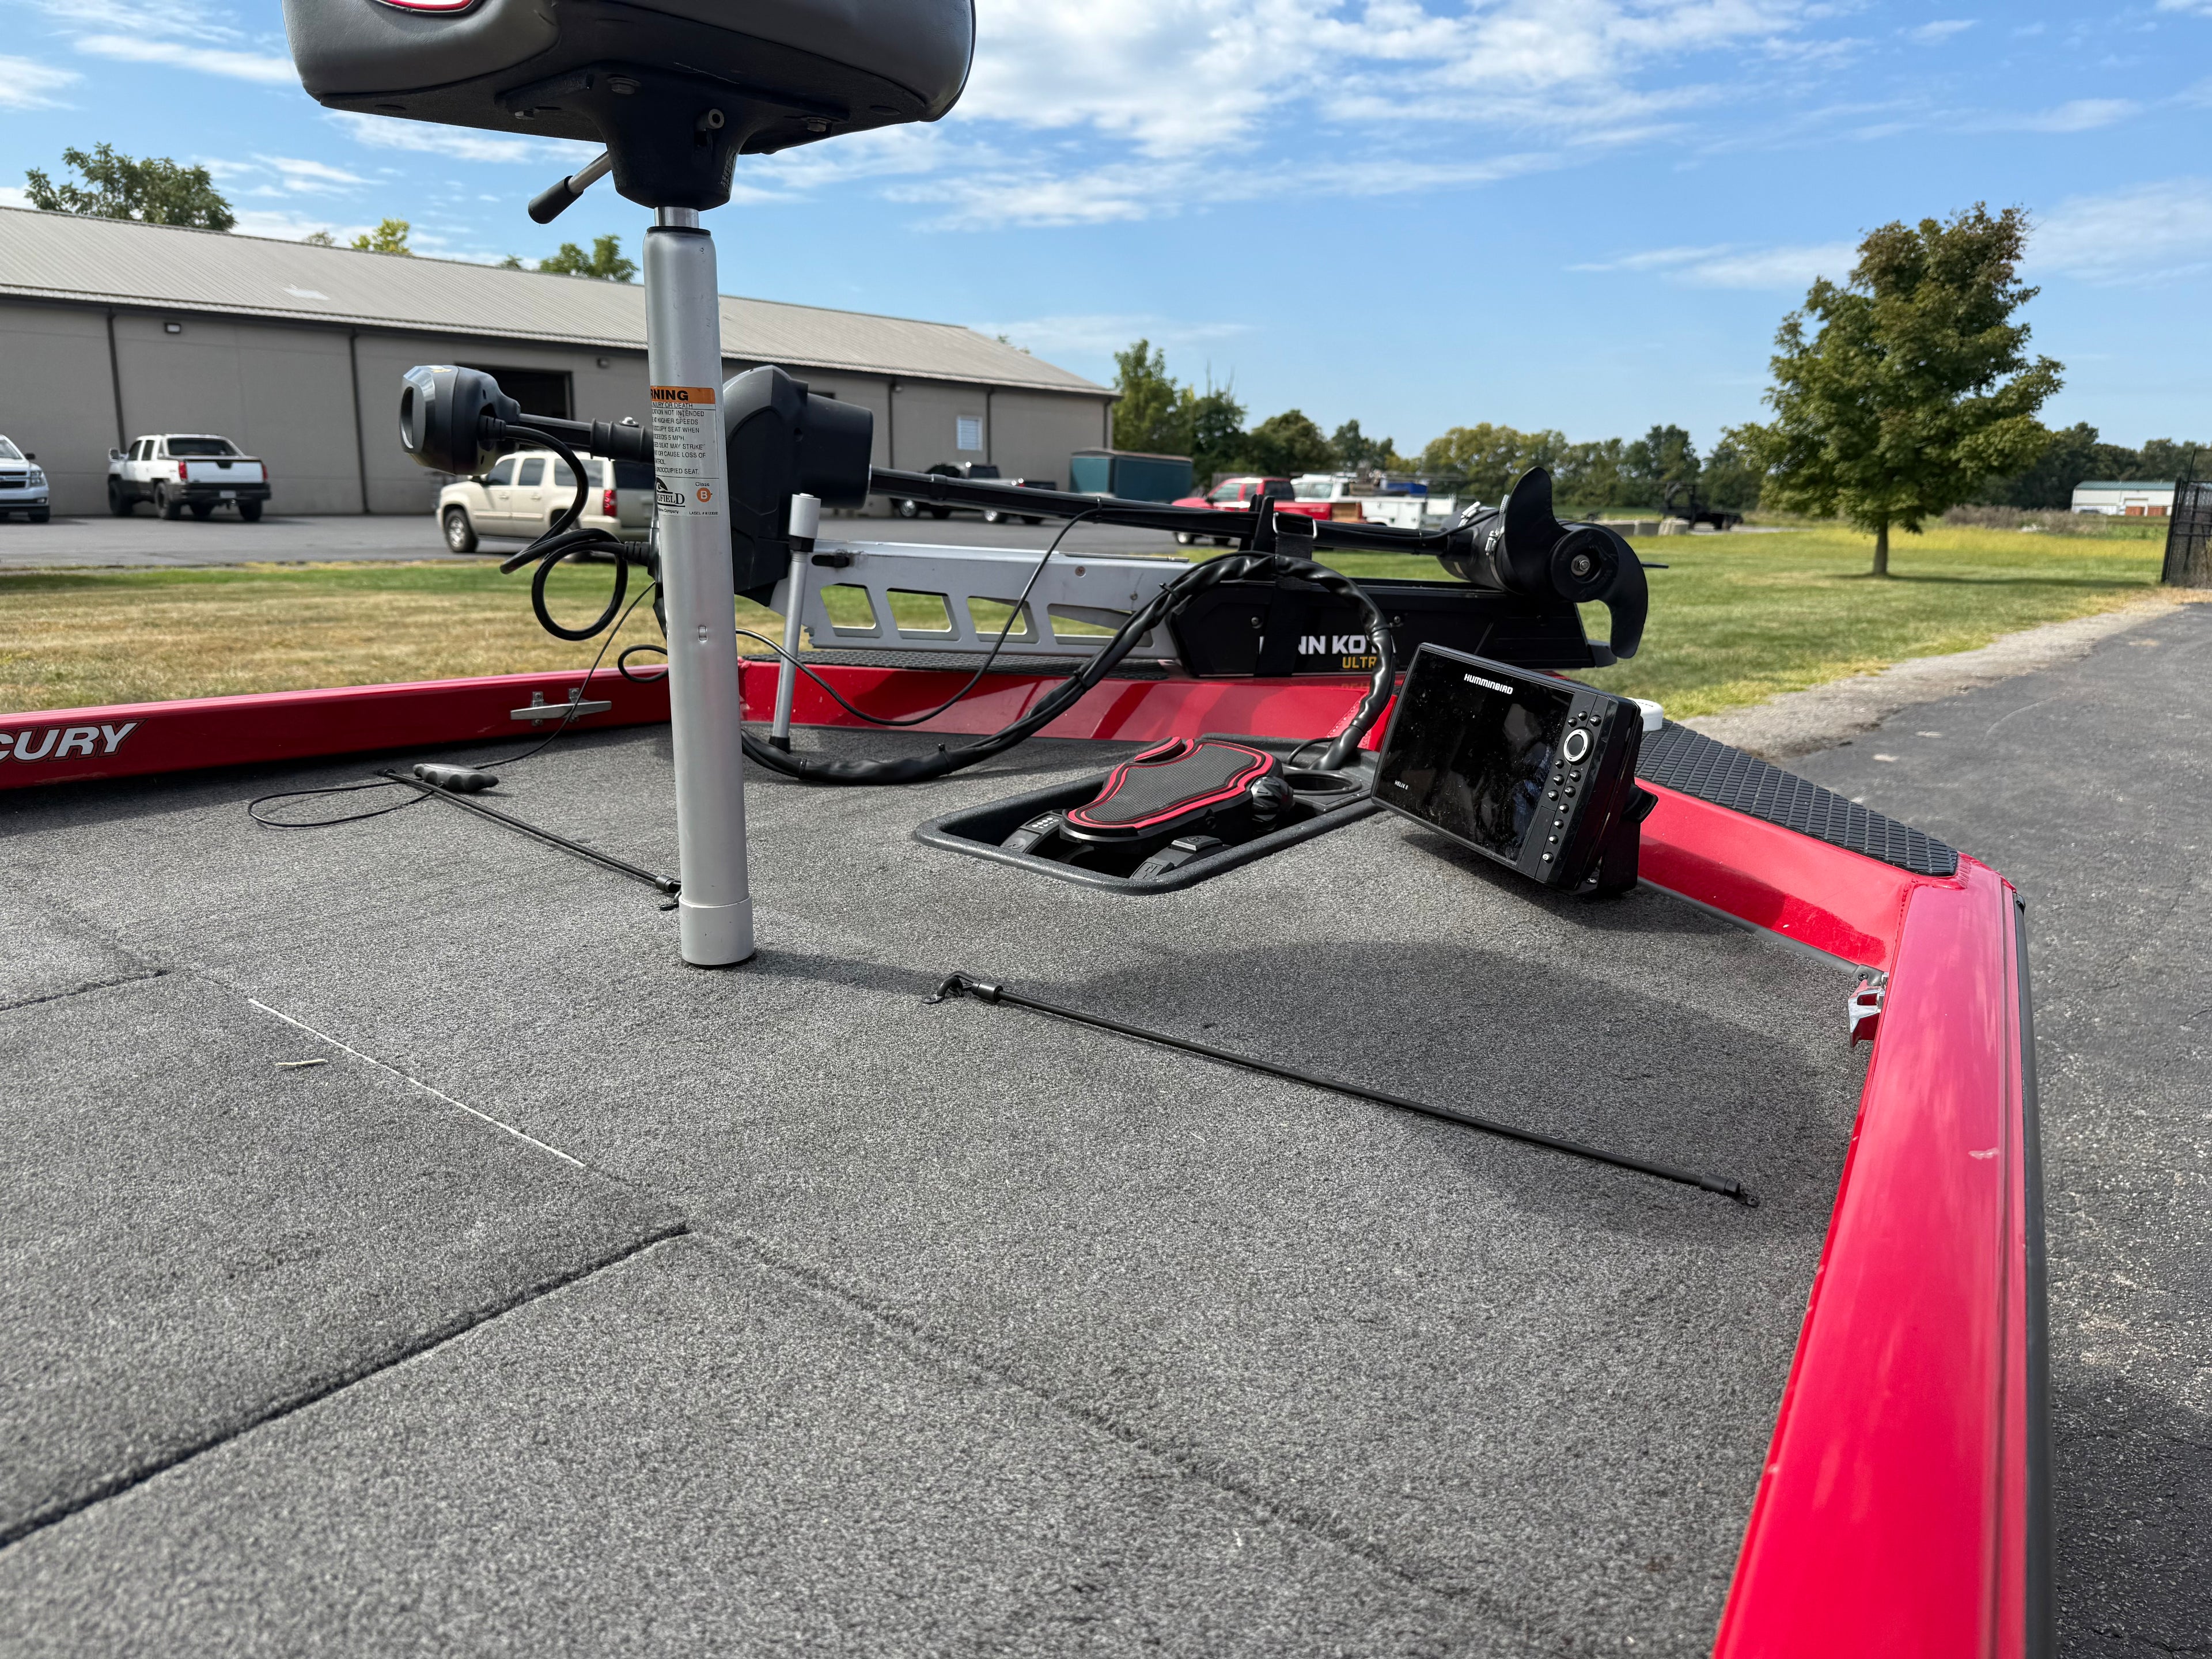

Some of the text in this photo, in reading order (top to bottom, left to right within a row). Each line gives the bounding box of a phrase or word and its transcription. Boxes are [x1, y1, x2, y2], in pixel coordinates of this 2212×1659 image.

[700, 491, 707, 499] B
[1342, 656, 1378, 669] ULTR
[1394, 780, 1406, 789] HELIX
